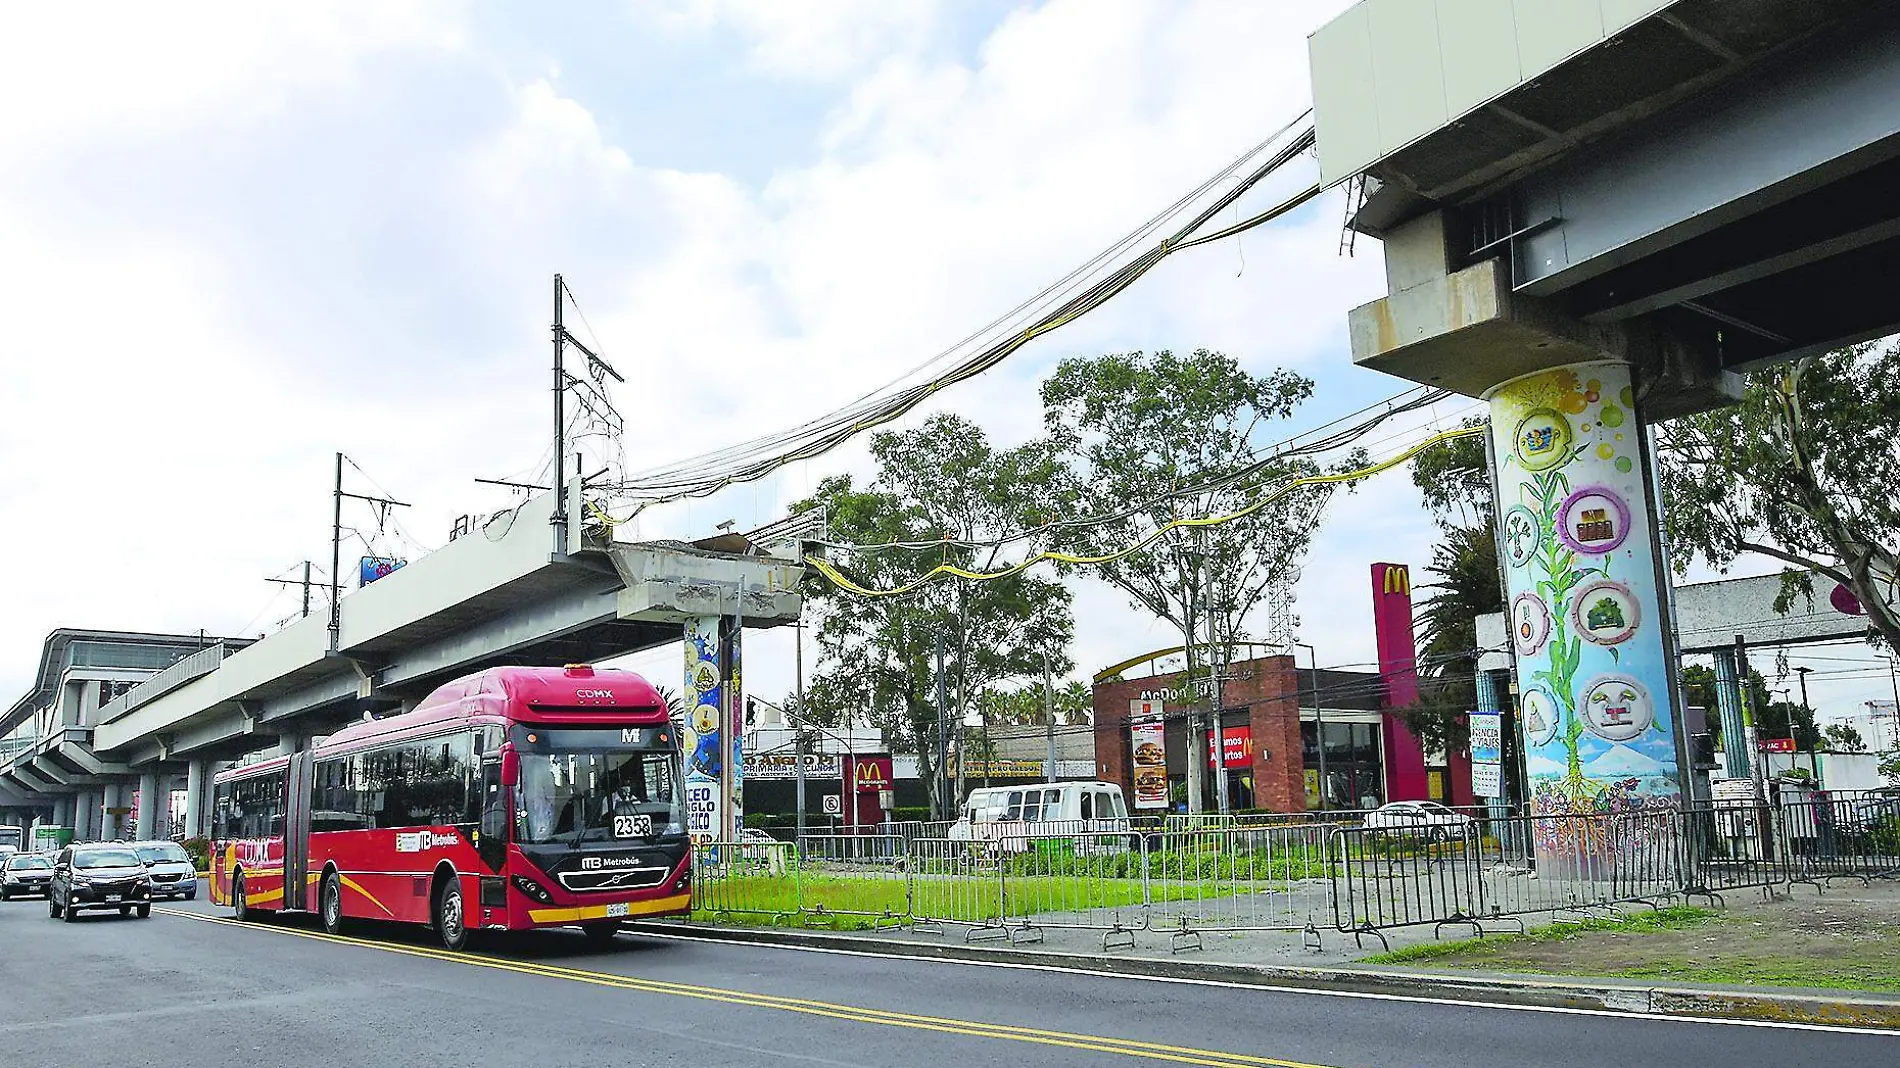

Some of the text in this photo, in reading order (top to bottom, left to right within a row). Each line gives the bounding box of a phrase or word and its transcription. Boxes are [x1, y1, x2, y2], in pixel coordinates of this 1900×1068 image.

[576, 689, 613, 699] CDMX
[743, 764, 788, 772] PRIMARIA
[615, 817, 651, 836] 2358
[603, 856, 639, 867] Metrobús
